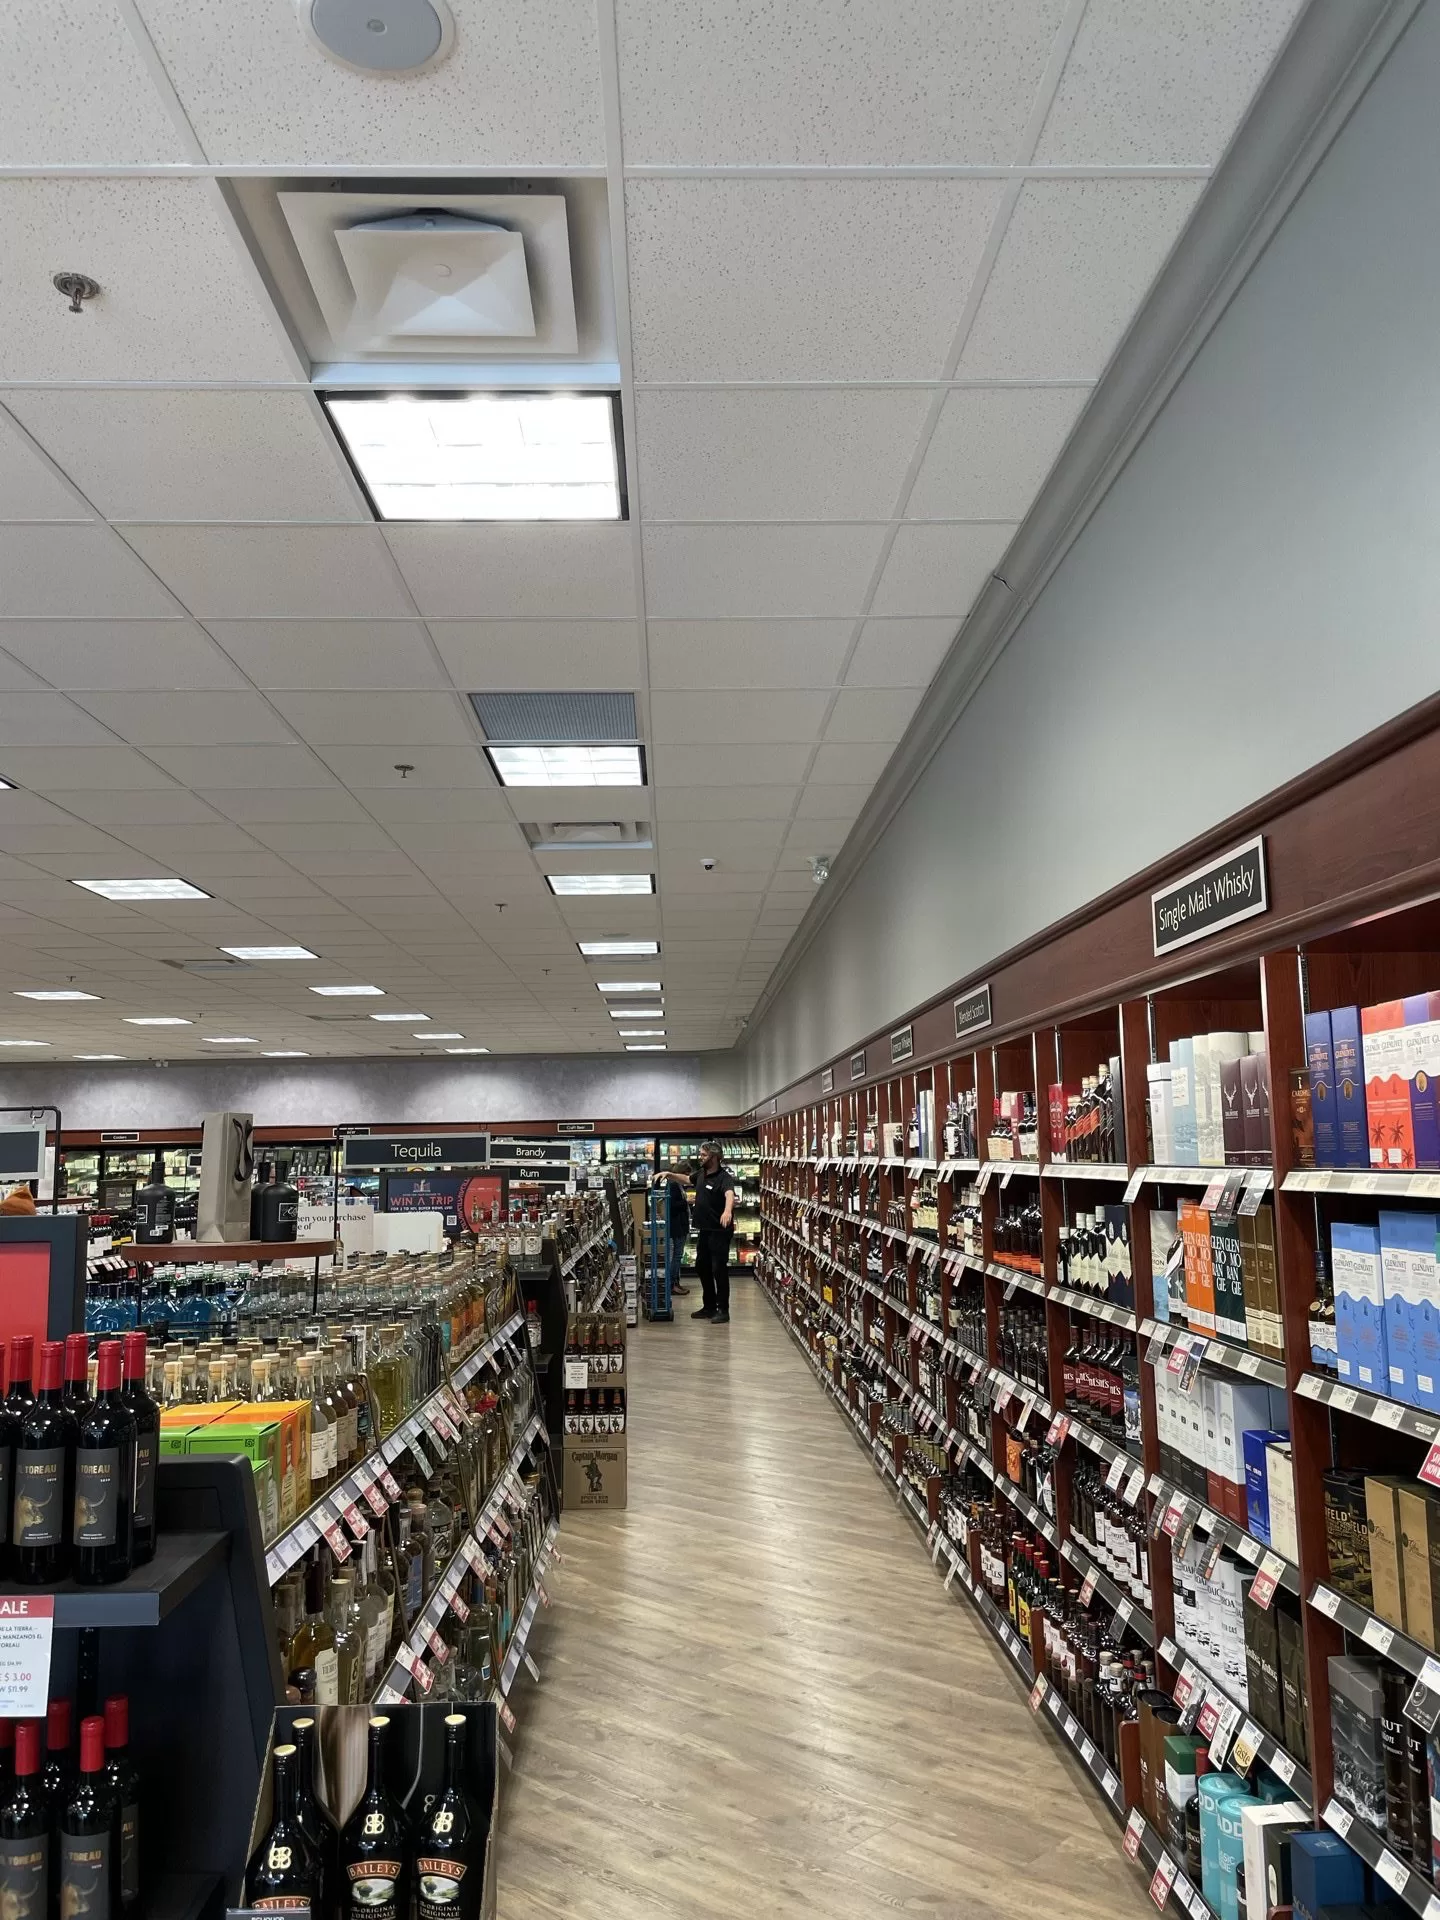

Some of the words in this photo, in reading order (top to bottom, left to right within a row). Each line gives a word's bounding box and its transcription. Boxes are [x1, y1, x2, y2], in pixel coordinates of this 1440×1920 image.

[1159, 898, 1187, 931] Single
[1188, 883, 1212, 917] Malt
[1213, 864, 1254, 903] Whisky
[971, 999, 985, 1019] Scotch
[391, 1142, 442, 1160] Tequila
[516, 1148, 546, 1158] Brandy
[520, 1169, 540, 1178] Rum
[390, 1197, 413, 1206] WIN
[429, 1196, 454, 1206] TRIP
[312, 1216, 327, 1224] you
[328, 1214, 366, 1223] prchase
[1224, 1238, 1240, 1253] GLEN
[1215, 1249, 1226, 1264] MO
[1229, 1253, 1241, 1268] MO
[1353, 1263, 1373, 1273] GLENLIVET
[1385, 1259, 1407, 1270] GLENLIVET
[1412, 1263, 1435, 1274] GLENLIVET
[1226, 1265, 1239, 1281] RAN
[1201, 1273, 1211, 1288] GIE
[1216, 1277, 1226, 1291] GIE
[1231, 1281, 1242, 1295] GIE
[572, 1450, 593, 1463] Captain
[594, 1450, 618, 1462] Morgan
[25, 1464, 57, 1475] TOREAU
[80, 1464, 111, 1475] TOREAU
[0, 1600, 29, 1615] ALE
[12, 1672, 32, 1681] 3.00
[7, 1685, 28, 1694] $11.99
[1235, 1744, 1250, 1765] taste
[349, 1863, 397, 1878] BAILEYS
[418, 1860, 461, 1876] BAILEYS
[361, 1904, 397, 1913] ORIGINAL
